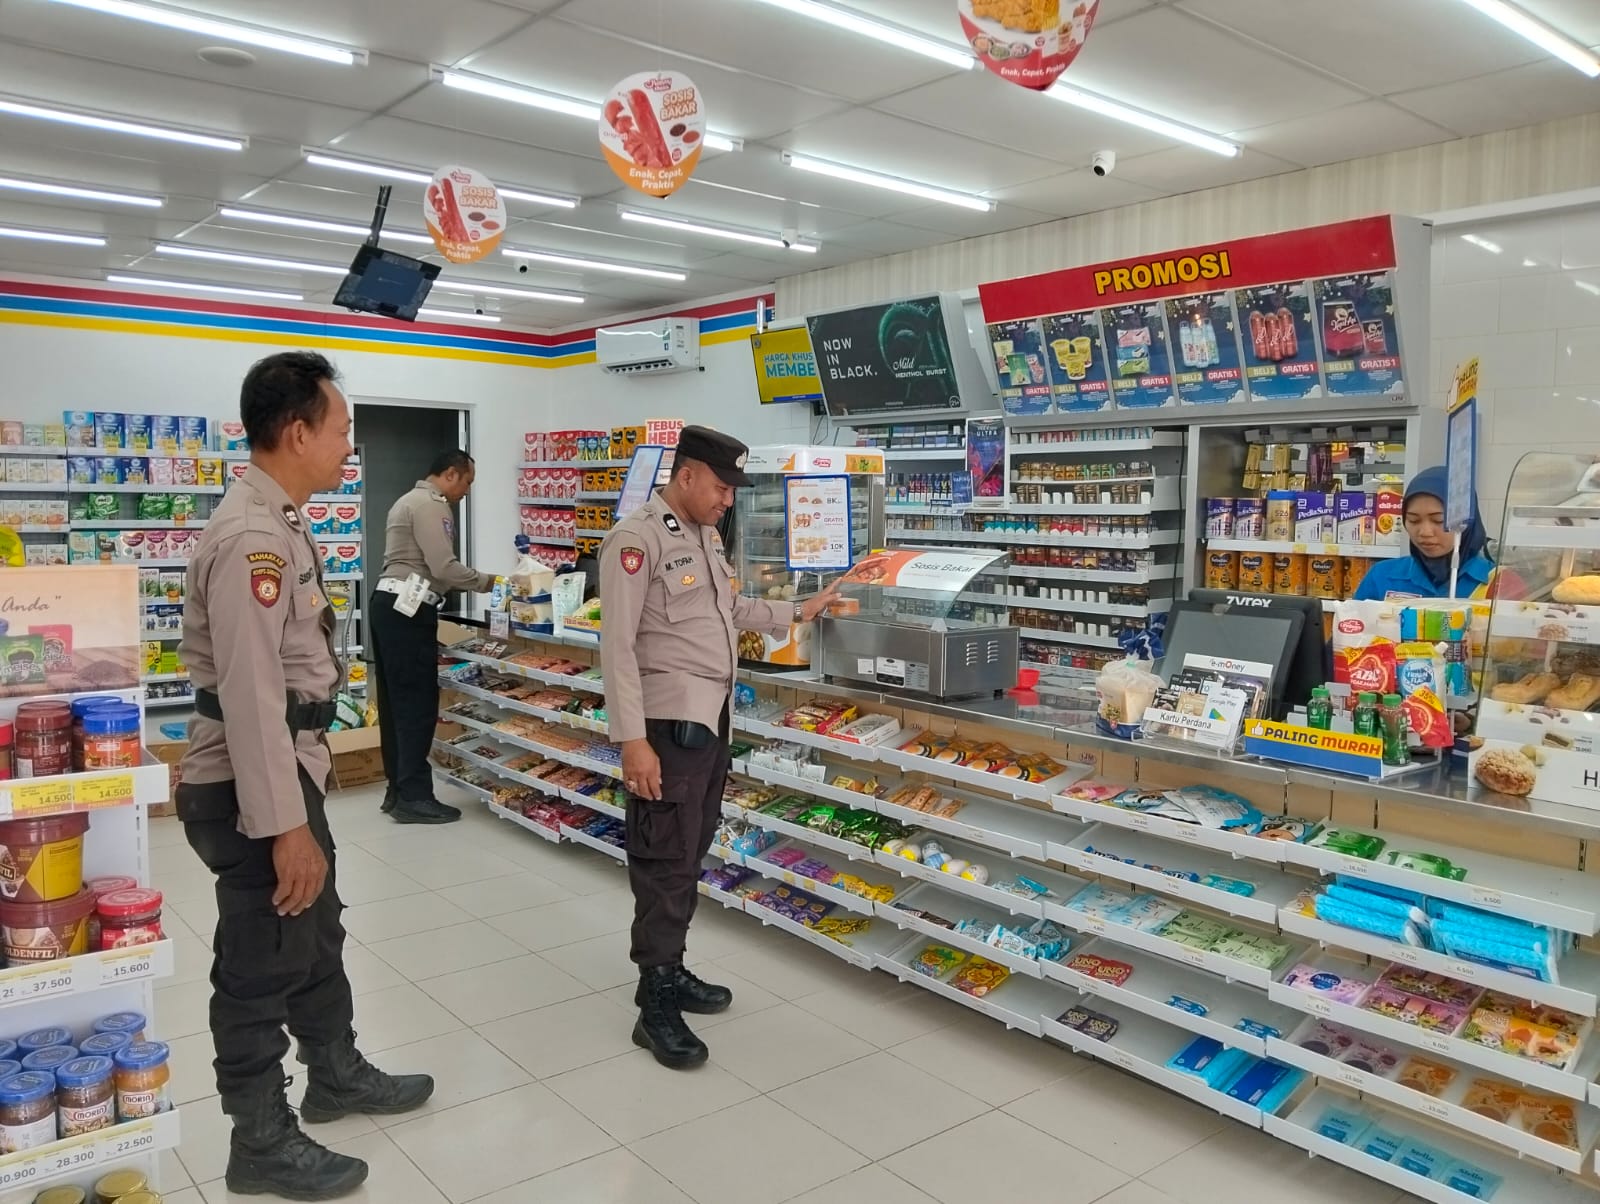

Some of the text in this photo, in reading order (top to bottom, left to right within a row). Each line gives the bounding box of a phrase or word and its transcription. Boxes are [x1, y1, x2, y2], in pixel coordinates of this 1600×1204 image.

[663, 87, 695, 106] SOSIS
[660, 101, 697, 121] BAKAR
[462, 186, 495, 198] SOSIS
[1094, 251, 1231, 295] PROMOSI
[823, 338, 852, 352] NOW
[764, 352, 813, 363] HARGA KHUS
[826, 353, 840, 366] IN
[765, 362, 816, 378] MEMBE
[1282, 364, 1309, 373] GRATIS
[1361, 360, 1388, 369] GRATIS
[830, 365, 878, 380] BLACK.
[895, 368, 947, 379] MENTHOL BURST
[1208, 371, 1233, 379] GRATIS
[1080, 383, 1100, 391] GRATIS
[1141, 378, 1162, 386] GRATIS
[1025, 387, 1044, 395] GRATIS
[647, 420, 683, 431] TEBUS
[648, 431, 679, 445] HEB
[1298, 507, 1334, 520] PediaSure
[1340, 508, 1373, 521] PediaSure
[911, 561, 975, 573] Sosis Bakar
[2, 596, 50, 612] Anda
[1350, 668, 1380, 682] ABC
[1419, 689, 1435, 705] 35%
[1160, 712, 1212, 729] Kartu Perdana
[1265, 727, 1382, 756] PALING MURAH
[40, 787, 132, 805] 14.500 14.500
[1073, 957, 1101, 967] UNO
[32, 976, 72, 992] 37.500
[113, 961, 150, 976] 15.600
[1097, 965, 1125, 975] UNO
[1067, 1011, 1088, 1020] UNO
[1089, 1019, 1111, 1029] UNO
[76, 1106, 104, 1121] MORIN
[56, 1151, 95, 1168] 28.300
[117, 1135, 153, 1152] 22.500
